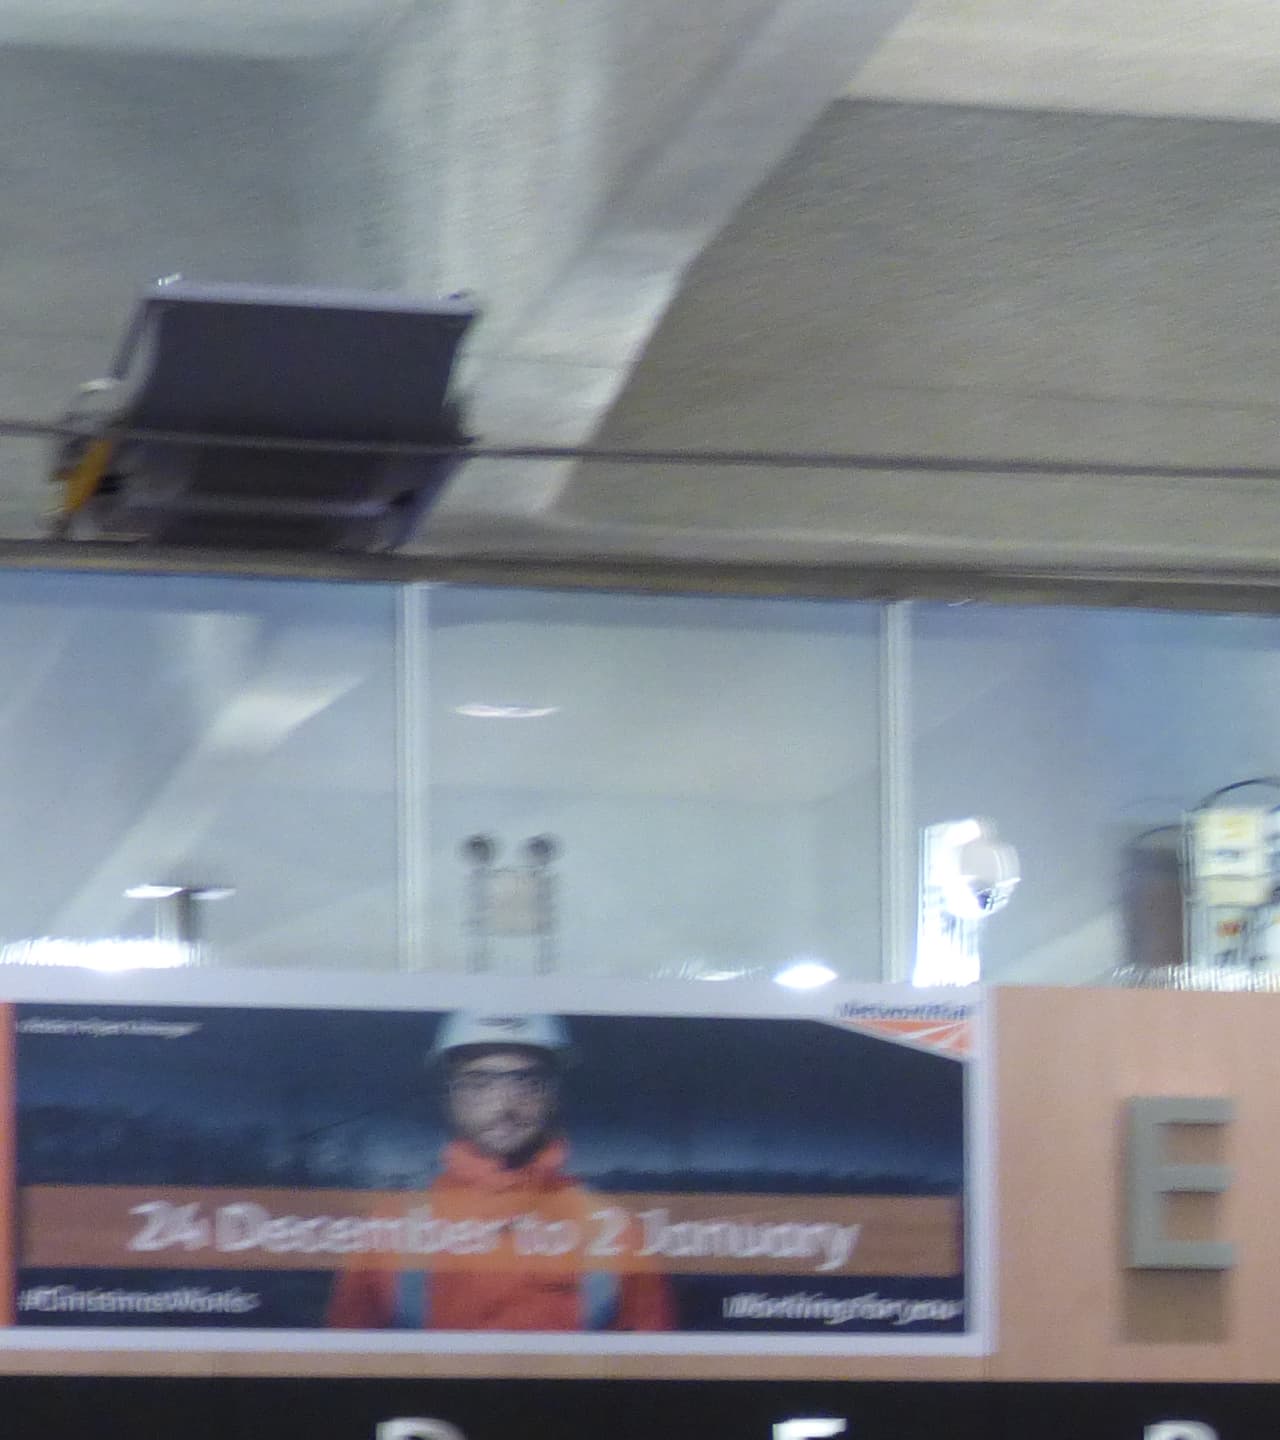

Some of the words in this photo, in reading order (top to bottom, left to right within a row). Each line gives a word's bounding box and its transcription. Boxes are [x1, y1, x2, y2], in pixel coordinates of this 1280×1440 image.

[127, 1201, 205, 1254] 24
[214, 1204, 511, 1258] December
[519, 1207, 578, 1257] to
[586, 1208, 627, 1258] 2
[633, 1209, 863, 1271] January
[16, 1285, 260, 1316] #ChristmasWorks
